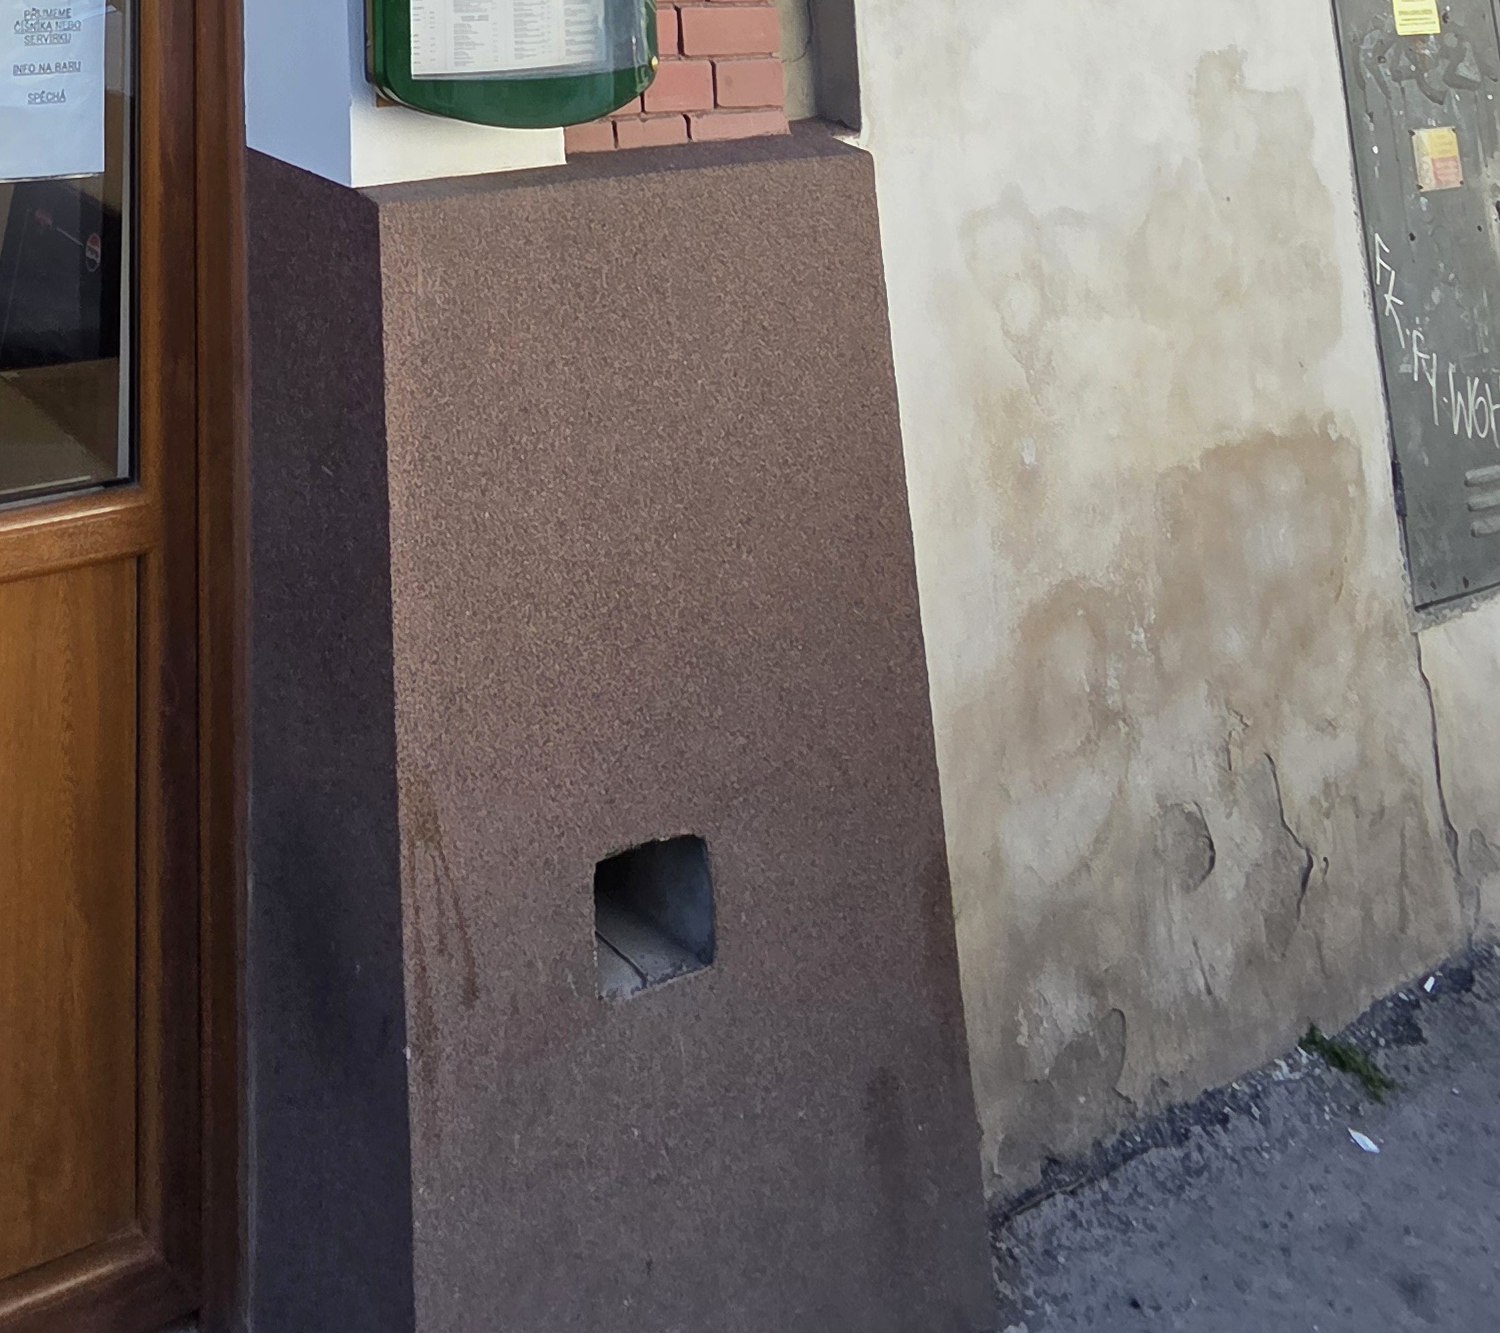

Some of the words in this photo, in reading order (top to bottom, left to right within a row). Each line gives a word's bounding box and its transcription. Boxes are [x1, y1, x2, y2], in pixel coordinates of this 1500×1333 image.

[13, 64, 35, 75] INFO
[39, 63, 52, 73] NA
[55, 61, 81, 73] BARU
